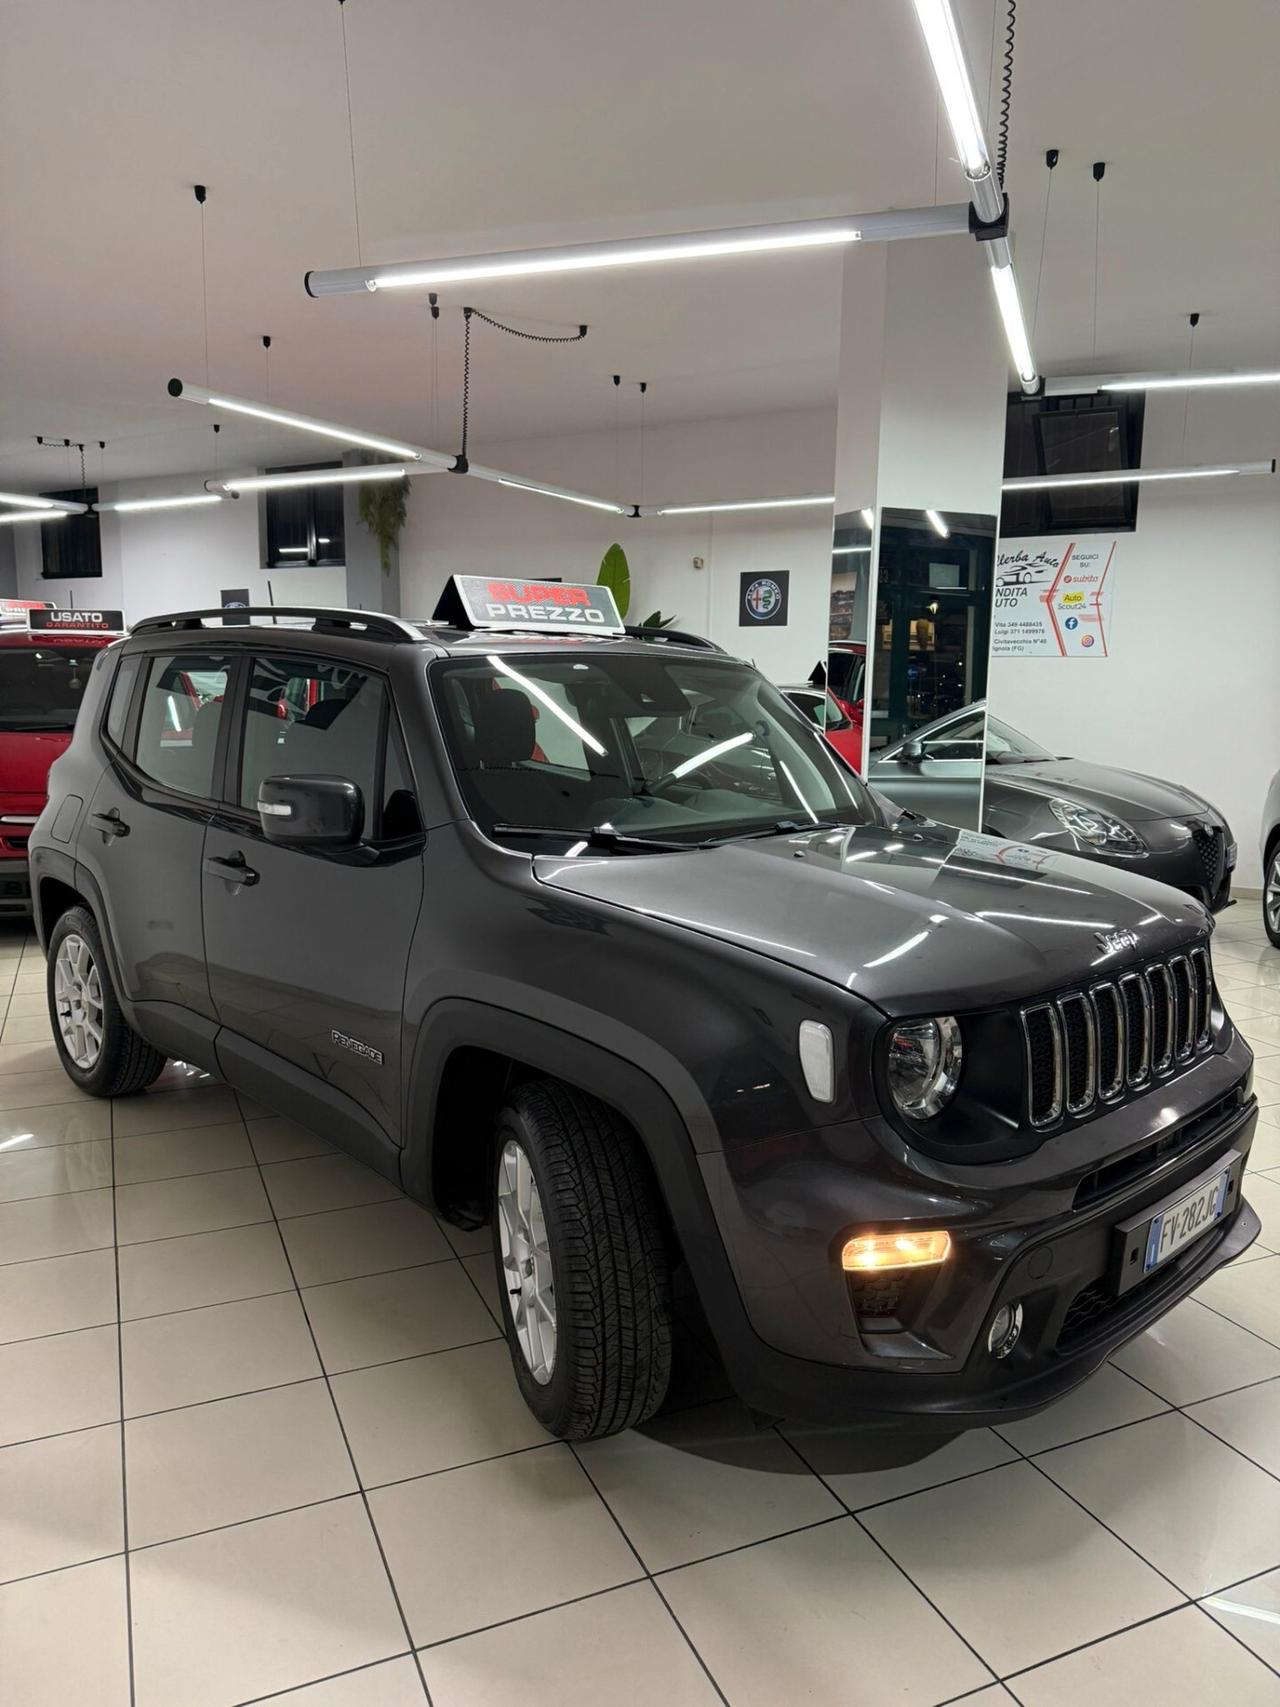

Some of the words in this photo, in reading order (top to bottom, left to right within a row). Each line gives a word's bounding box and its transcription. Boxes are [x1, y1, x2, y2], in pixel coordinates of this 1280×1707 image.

[1032, 551, 1059, 568] Auto
[1073, 575, 1098, 583] subito
[487, 582, 591, 606] SUPER
[995, 587, 1028, 597] NDITA
[994, 597, 1018, 608] UTO
[1063, 594, 1082, 602] Auto
[50, 612, 103, 623] USATO
[485, 604, 605, 623] PREZZO
[1094, 929, 1140, 953] Jeep
